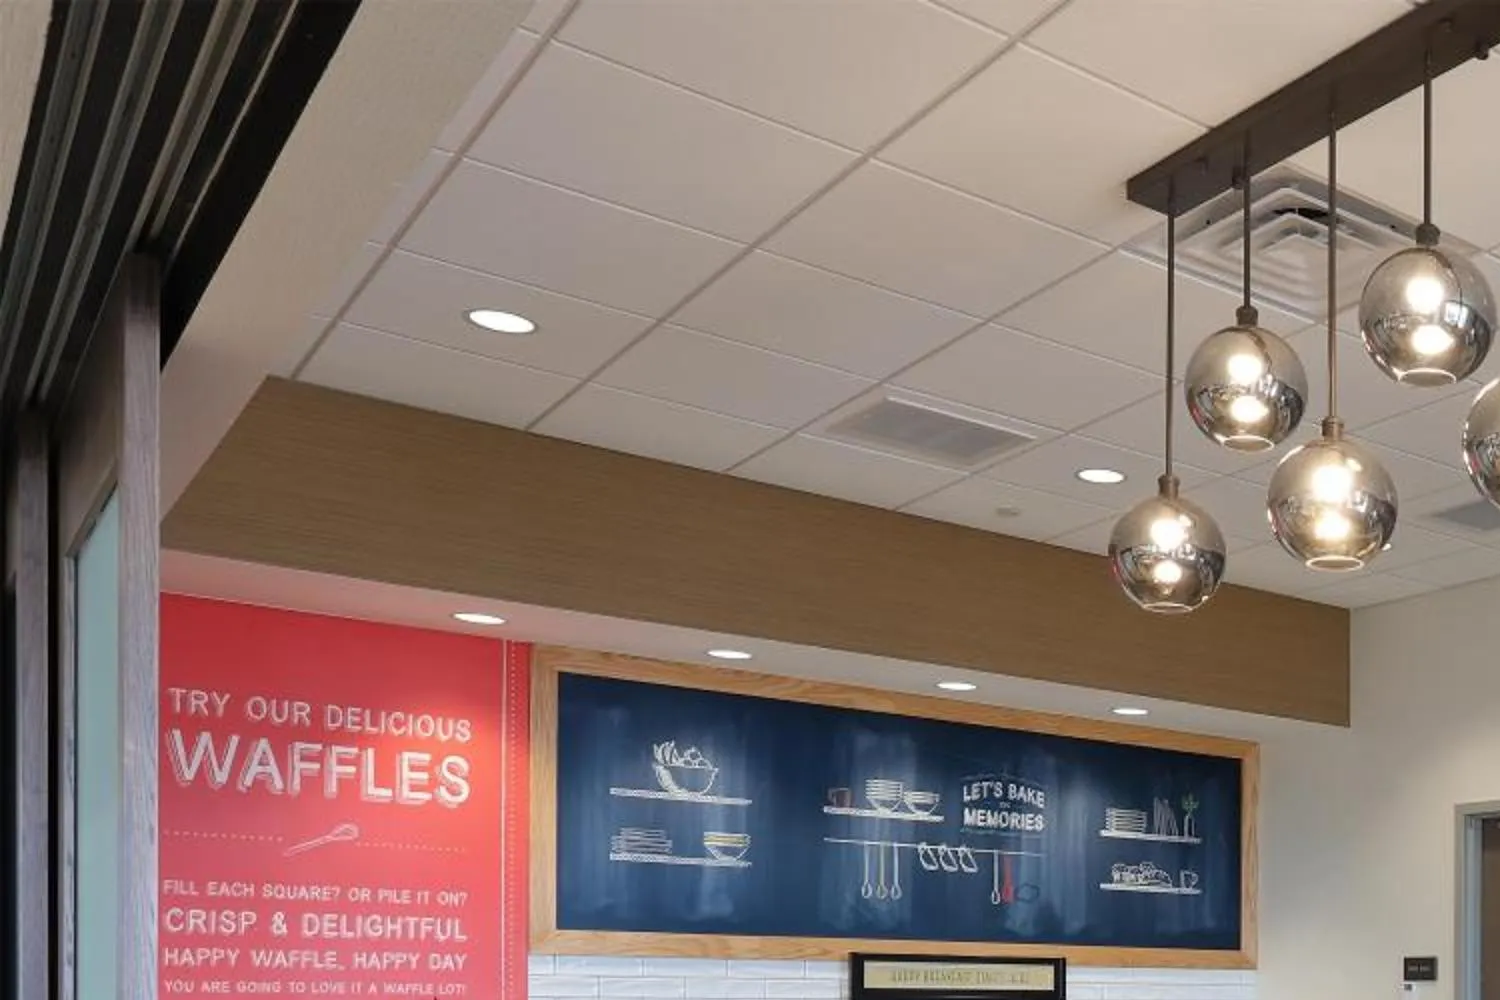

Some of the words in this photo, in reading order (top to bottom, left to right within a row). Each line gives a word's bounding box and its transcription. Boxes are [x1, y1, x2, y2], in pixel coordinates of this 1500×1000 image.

[168, 687, 231, 718] TRY
[245, 695, 312, 727] OUR
[326, 704, 473, 743] DELICIOUS
[165, 728, 472, 808] WAFFLES
[962, 781, 1003, 802] LET'S
[1007, 783, 1045, 809] BAKE
[962, 806, 1045, 832] MEMORIES
[163, 879, 199, 896] FILL
[207, 881, 255, 898] EACH
[261, 883, 341, 900] SQUARE?
[348, 887, 371, 902] OR
[378, 889, 411, 905] PILE
[416, 891, 429, 905] IT
[436, 891, 468, 907] ON?
[164, 907, 258, 936] CRISP
[271, 911, 288, 937] &
[302, 912, 468, 943] DELIGHTFUL
[164, 947, 241, 968] HAPPY
[353, 951, 420, 971] HAPPY
[428, 953, 468, 971] DAY
[164, 979, 195, 994] YOU
[200, 980, 231, 994] ARE
[236, 980, 281, 994] GOING
[288, 981, 306, 994] TO
[311, 980, 346, 994] LOVE
[351, 981, 362, 994] IT
[367, 981, 378, 994] A
[383, 981, 434, 995] WAFFLE
